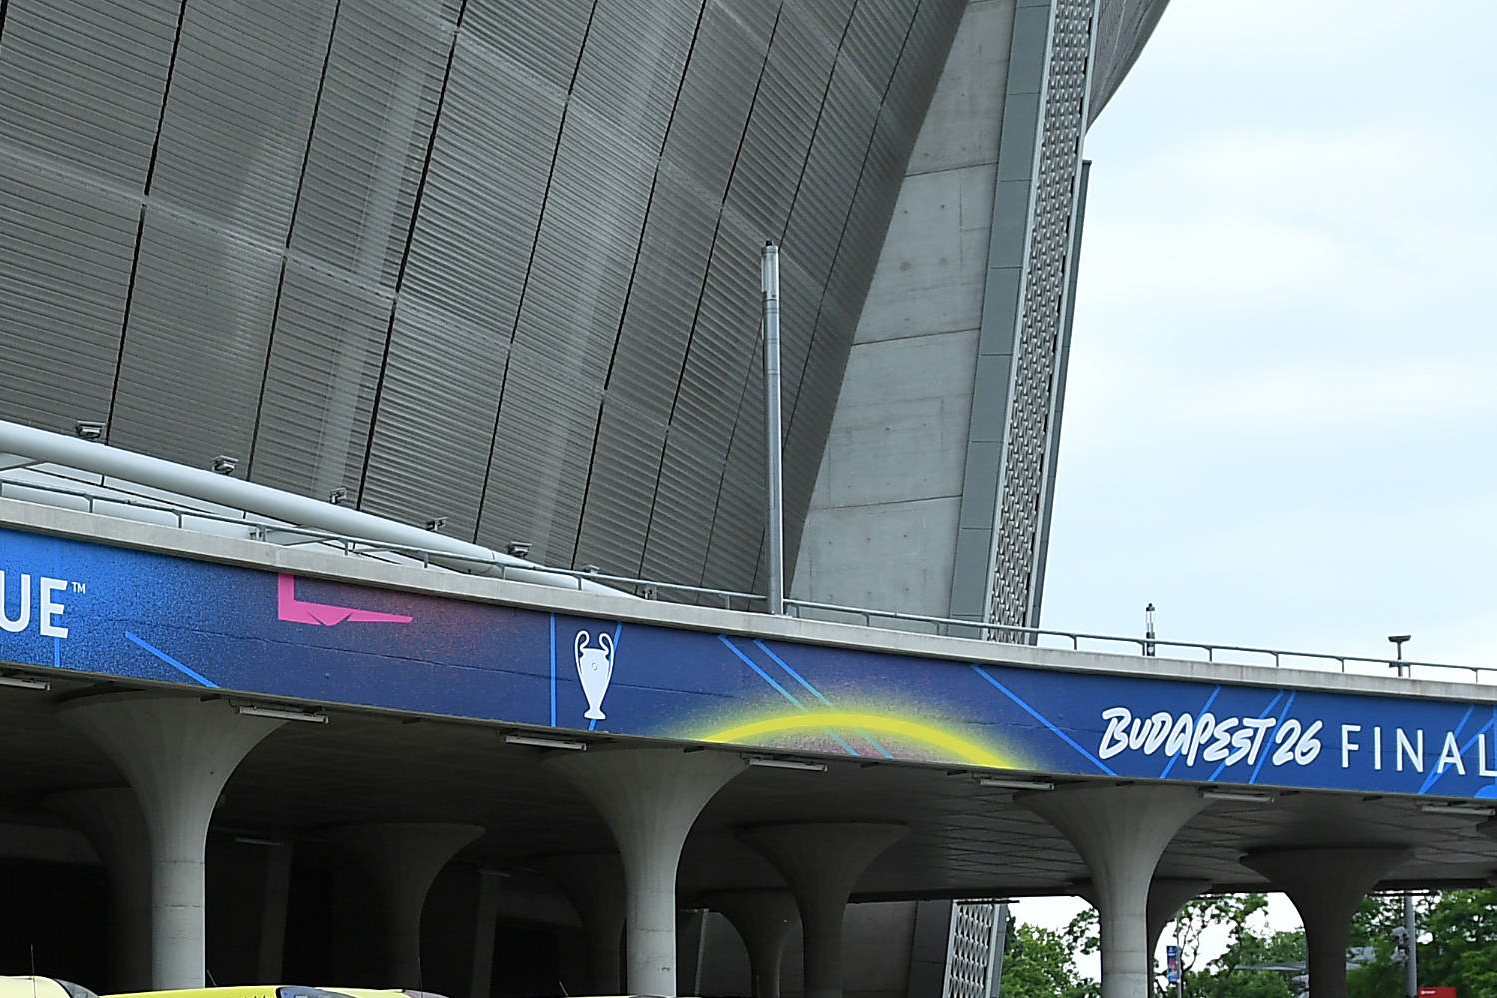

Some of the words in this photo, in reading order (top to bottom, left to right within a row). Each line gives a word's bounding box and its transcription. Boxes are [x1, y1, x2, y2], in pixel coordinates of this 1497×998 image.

[1098, 707, 1277, 767] BUDAPEST
[1272, 718, 1323, 766] 26
[1341, 724, 1497, 777] FINAL
